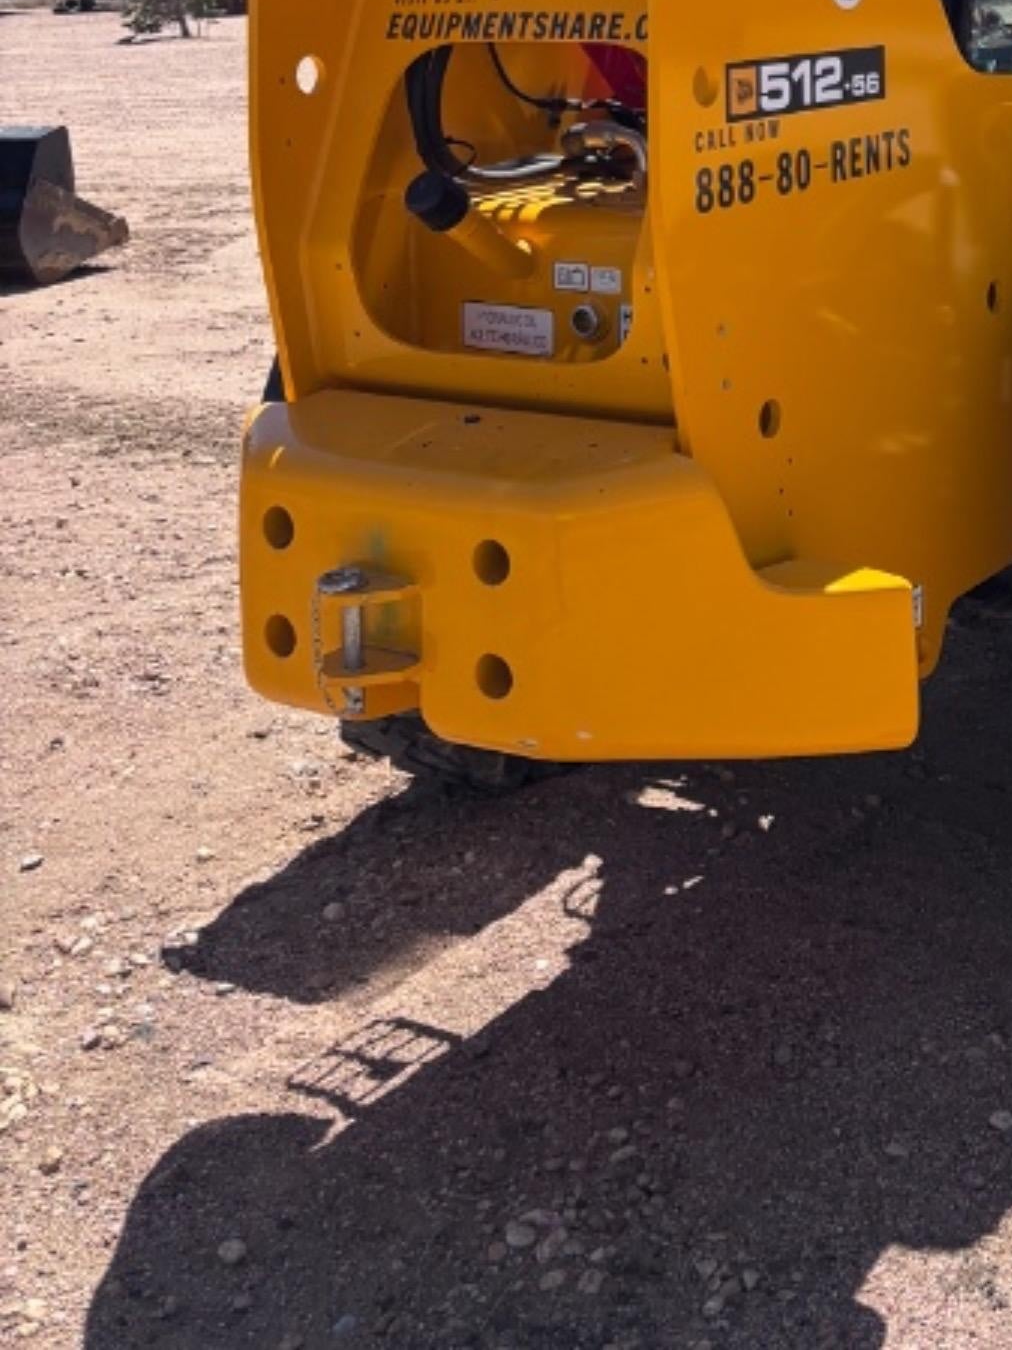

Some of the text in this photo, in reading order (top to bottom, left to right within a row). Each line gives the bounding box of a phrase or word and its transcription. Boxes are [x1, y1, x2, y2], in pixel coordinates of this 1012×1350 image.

[695, 119, 781, 153] CALL NOW
[695, 128, 911, 214] 888-80-RENTS
